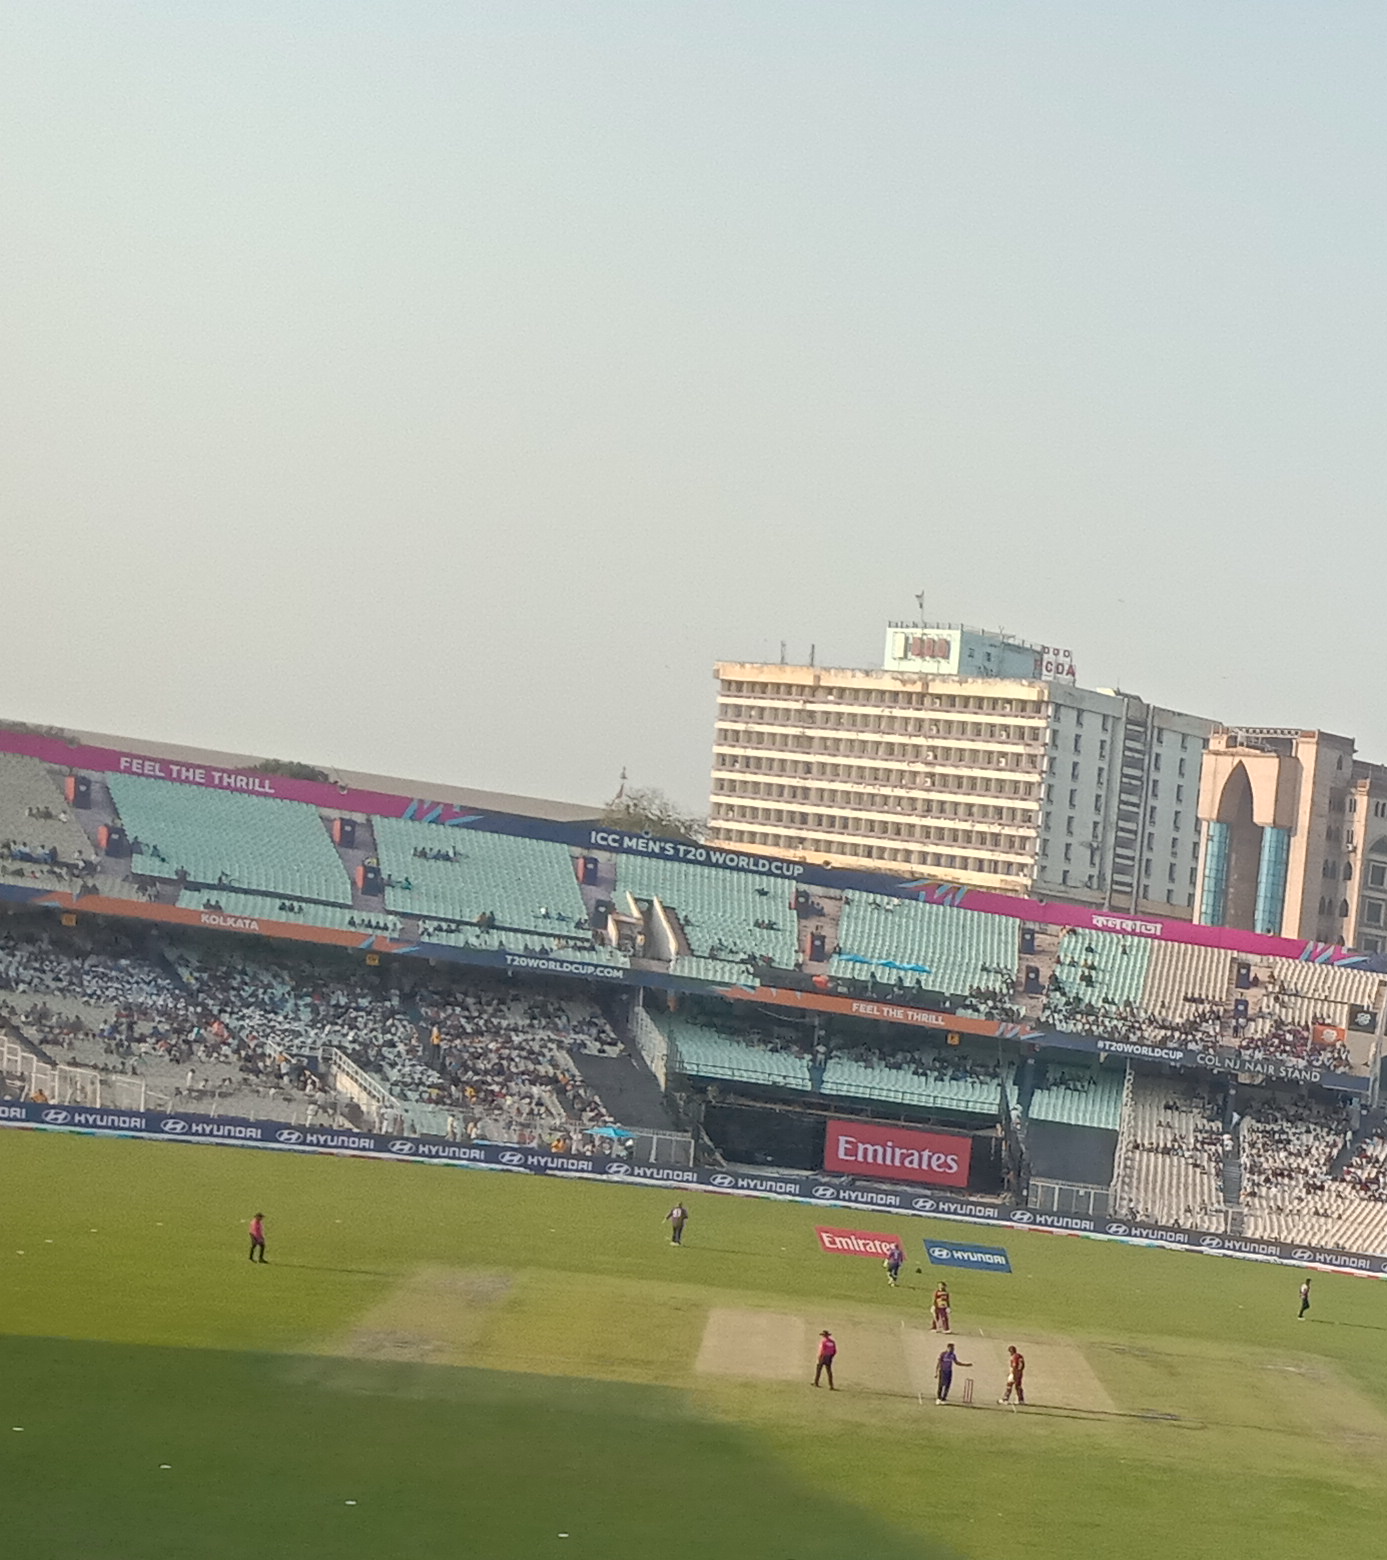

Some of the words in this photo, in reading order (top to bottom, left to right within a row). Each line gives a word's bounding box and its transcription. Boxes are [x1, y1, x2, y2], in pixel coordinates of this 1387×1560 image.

[120, 757, 165, 777] FEEL
[169, 764, 206, 783] THE
[211, 771, 275, 793] THRILL
[590, 830, 619, 847] ICC
[623, 836, 674, 856] MEN'S
[677, 844, 706, 862] T20
[709, 850, 769, 872] WORLD
[771, 861, 804, 877] CUP
[200, 913, 259, 930] KOLKATA
[1091, 914, 1163, 935] কলকাতা
[505, 955, 623, 978] T20WORLDCUP.COM
[852, 1002, 880, 1015] FEEL
[883, 1007, 904, 1018] THE
[907, 1011, 945, 1025] THRILL
[1097, 1040, 1183, 1060] #T20WORLDCUP
[1197, 1054, 1221, 1067] COL
[1225, 1057, 1241, 1070] NJ
[1244, 1061, 1275, 1075] NAIR
[1279, 1067, 1321, 1082] STAND
[74, 1112, 146, 1129] HYUNDAI
[191, 1123, 262, 1139] HYUNDAI
[306, 1133, 374, 1149] HYUNDAI
[418, 1143, 485, 1160] HYUNDAI
[837, 1135, 959, 1174] Emirates
[527, 1155, 593, 1172] HYUNDAI
[633, 1166, 697, 1183] HYUNDAI
[737, 1178, 800, 1195] HYUNDAI
[839, 1189, 900, 1206] HYUNDAI
[938, 1201, 998, 1218] HYUNDAI
[1036, 1214, 1094, 1231] HYUNDAI
[1131, 1226, 1188, 1243] HYUNDAI
[1224, 1239, 1280, 1256] HYUNDAI
[952, 1250, 1006, 1265] HYUNDAI
[1314, 1251, 1370, 1269] HYUNDAI
